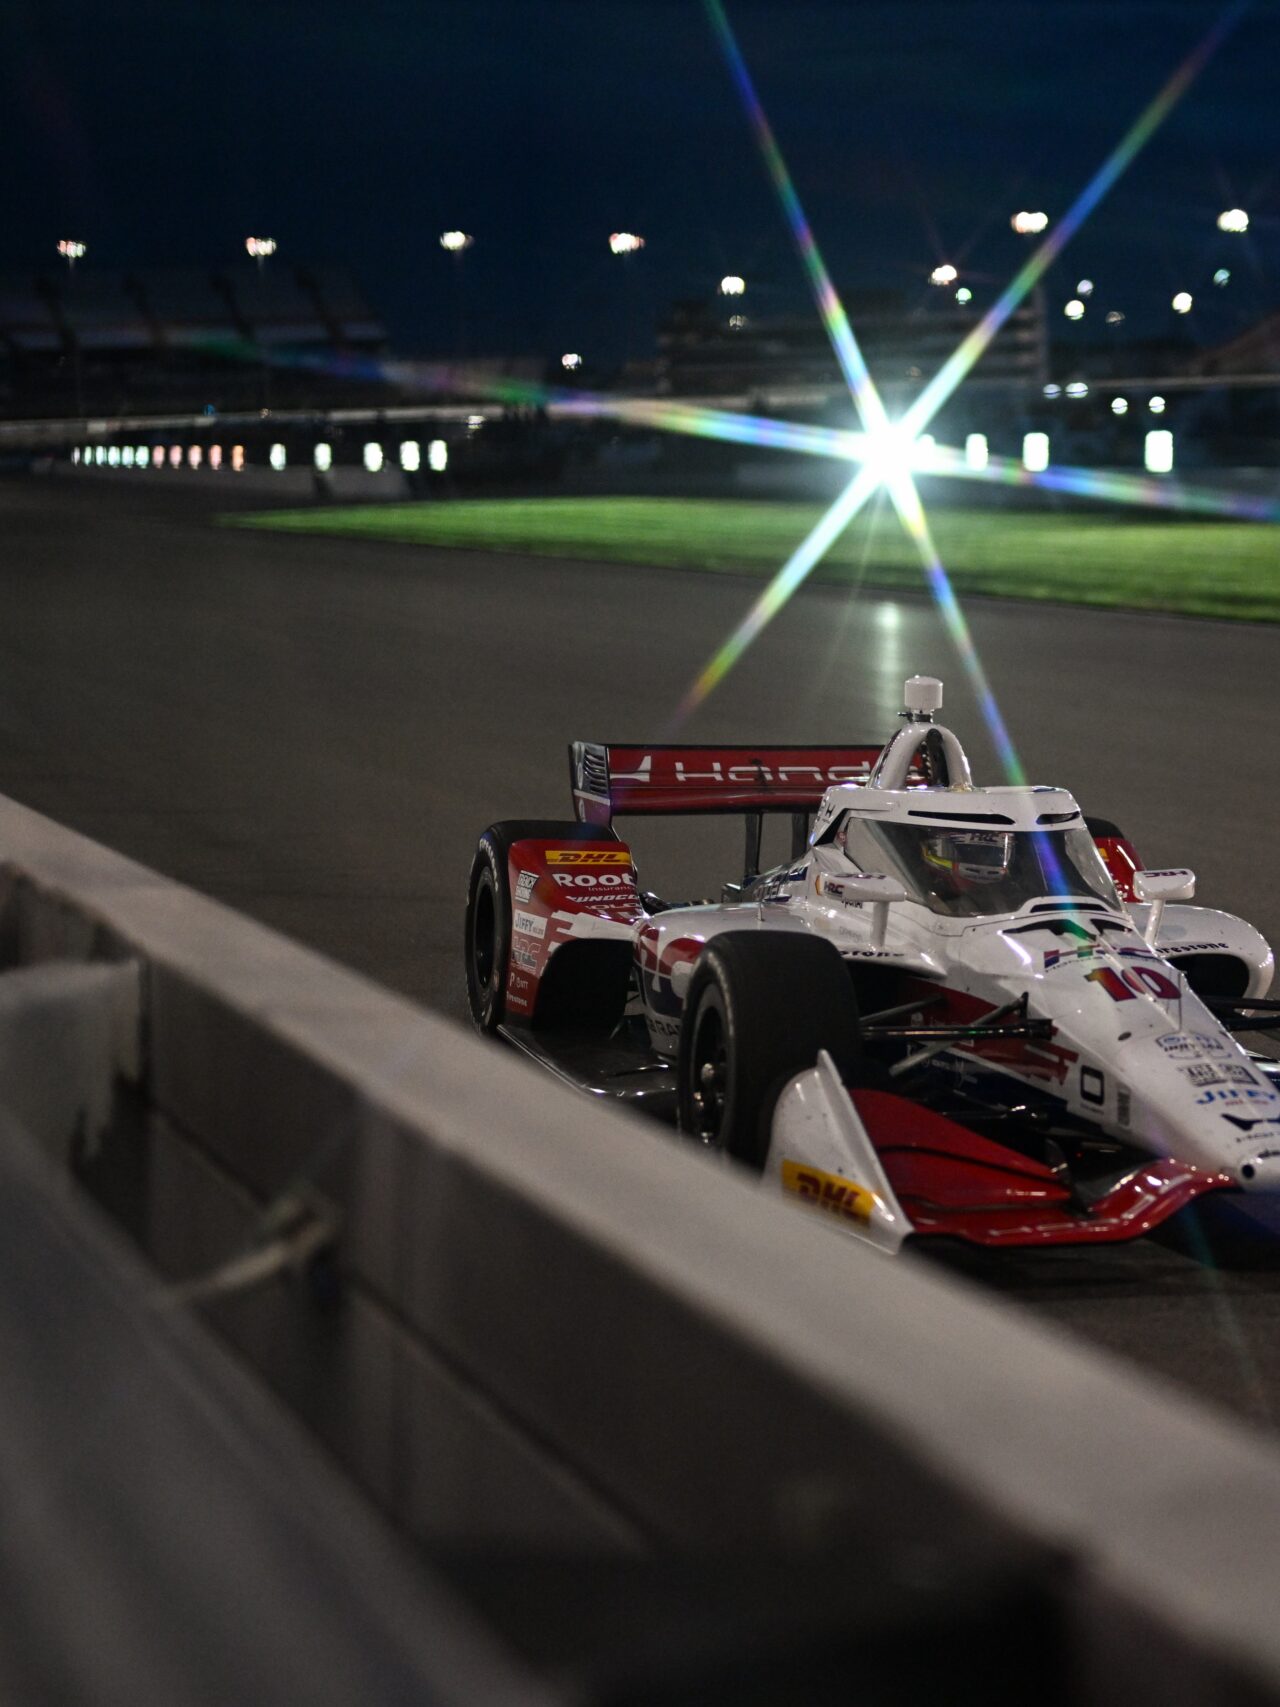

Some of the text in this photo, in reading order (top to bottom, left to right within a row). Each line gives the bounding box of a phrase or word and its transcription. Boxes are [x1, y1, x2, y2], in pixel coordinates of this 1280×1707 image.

[559, 852, 621, 863] DHL
[1155, 943, 1229, 954] irestone
[1084, 966, 1182, 1002] 10
[797, 1173, 863, 1222] DHL
